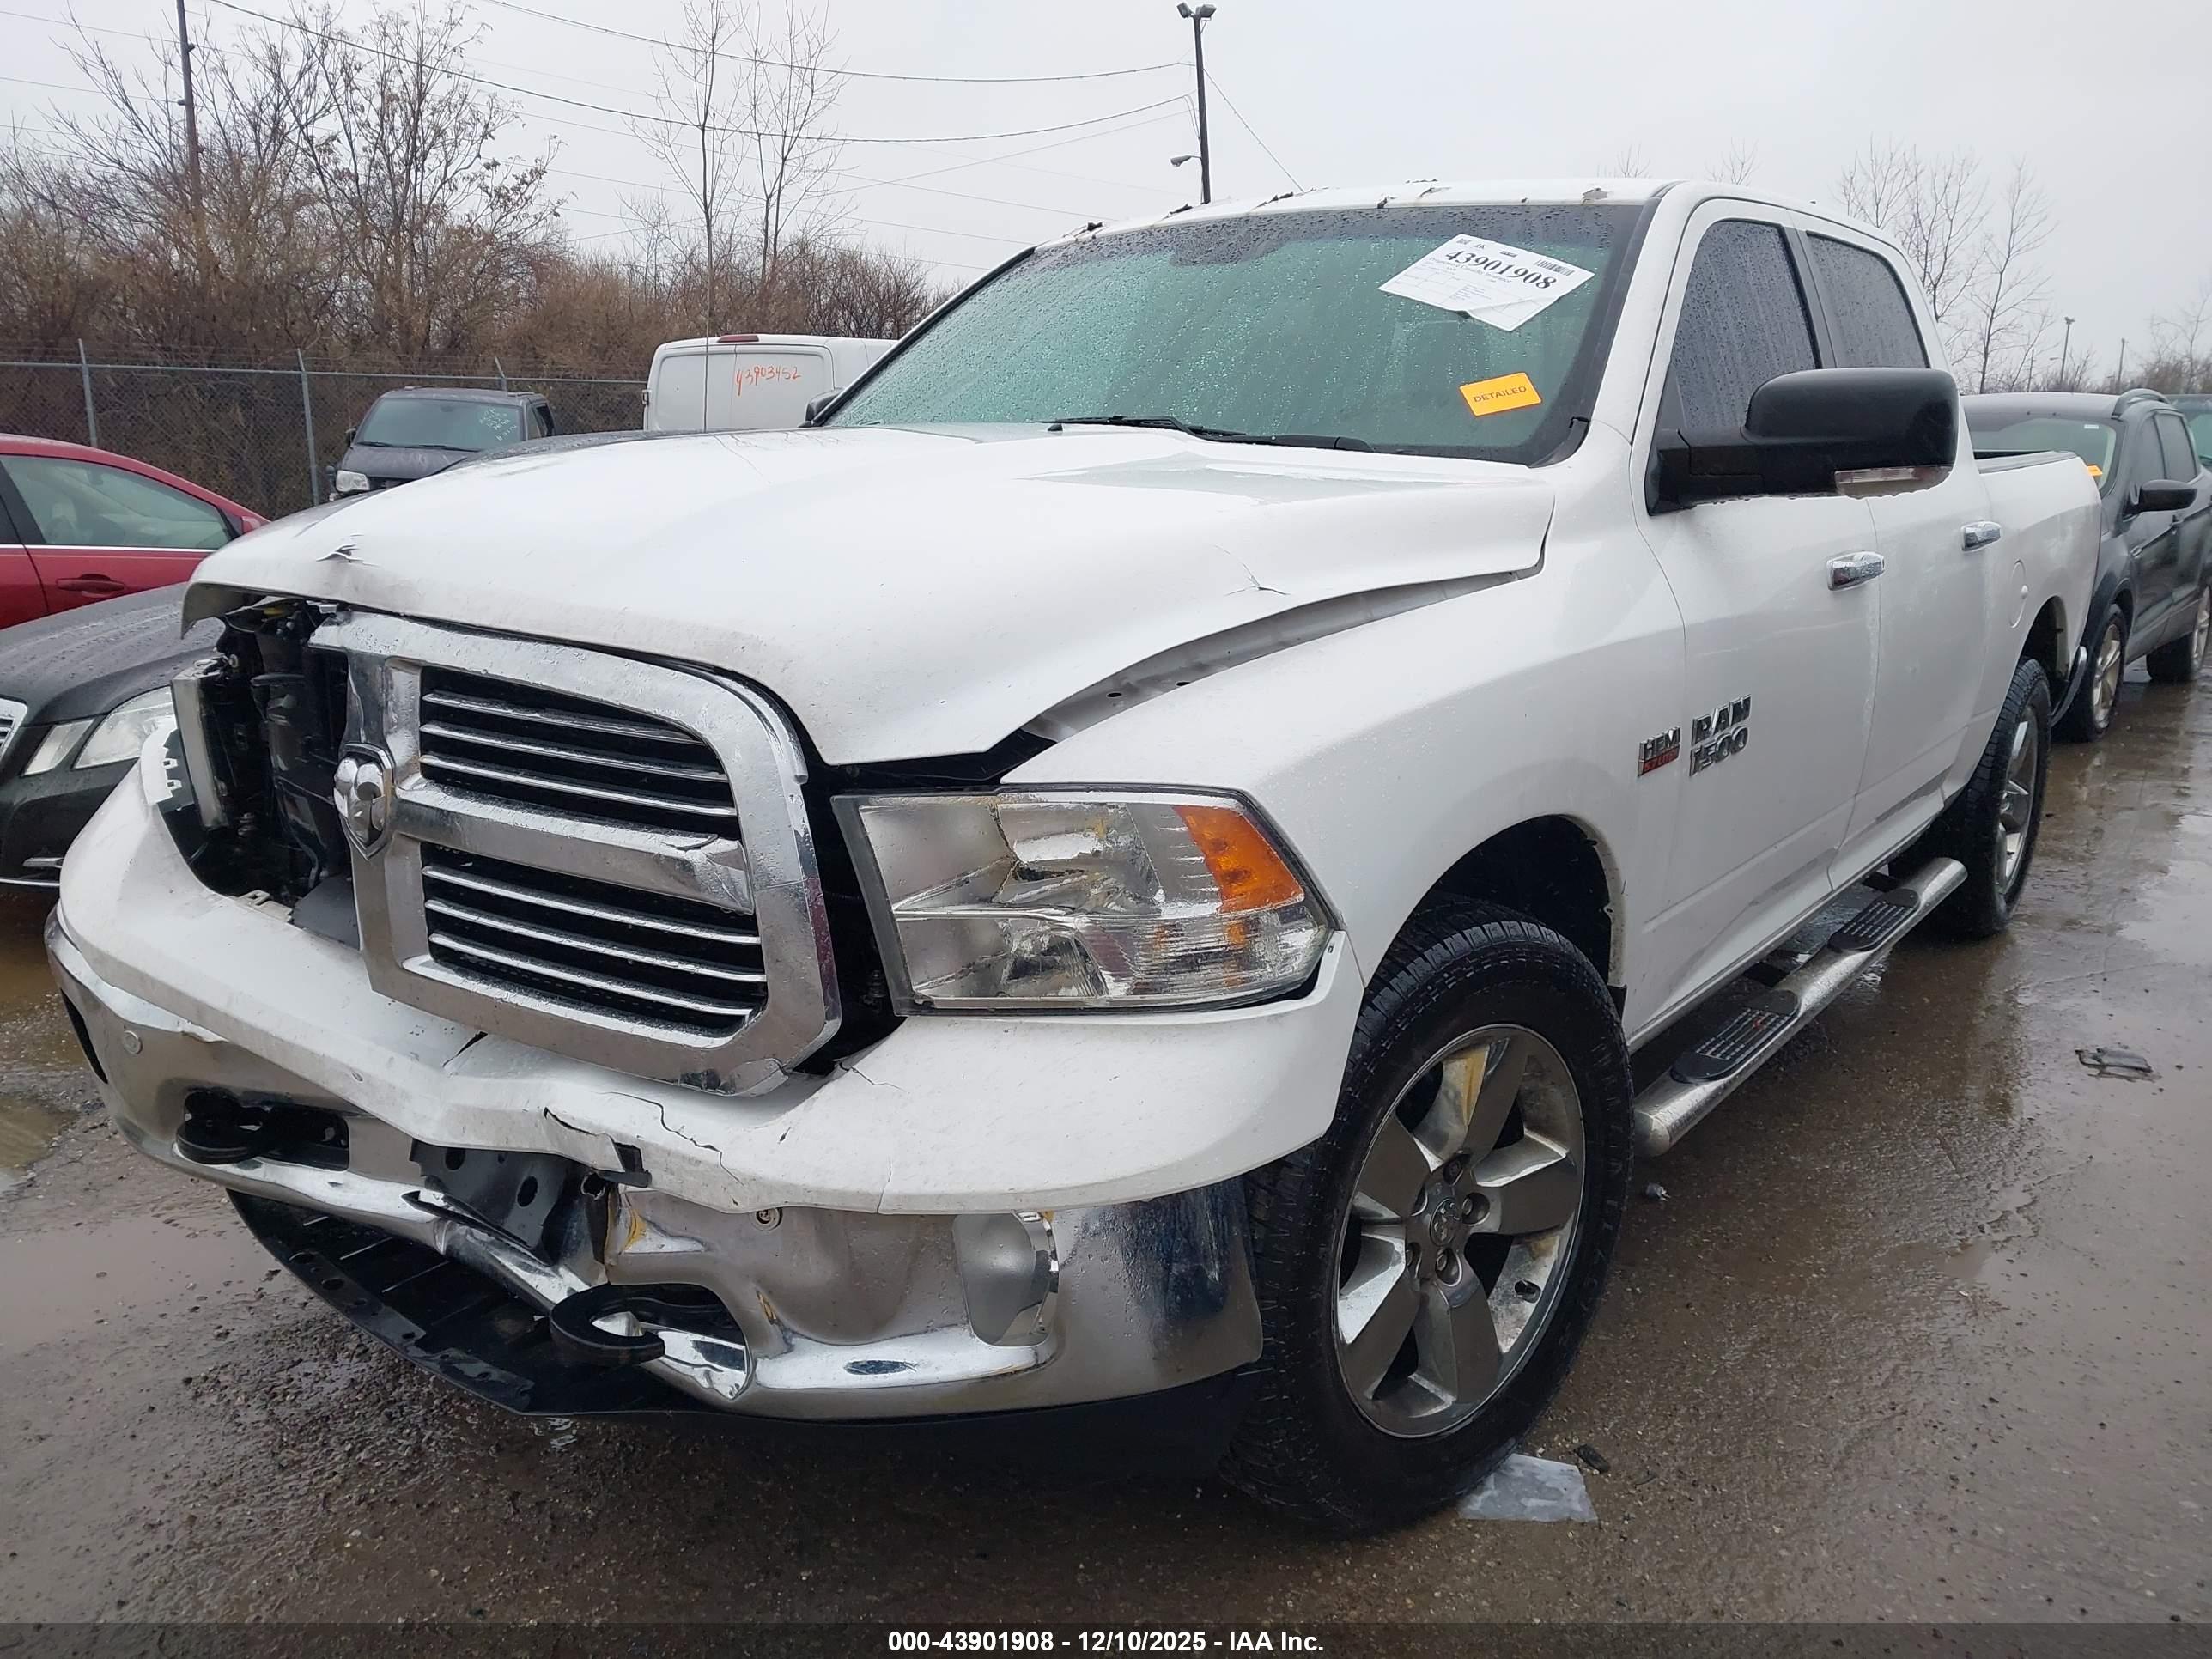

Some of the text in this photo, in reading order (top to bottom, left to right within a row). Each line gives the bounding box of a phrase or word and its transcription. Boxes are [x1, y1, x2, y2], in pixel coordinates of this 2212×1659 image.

[1445, 250, 1557, 289] 43901908
[1473, 386, 1527, 403] DETAILED
[1691, 694, 1751, 746] RAM
[1689, 725, 1749, 776] 1500
